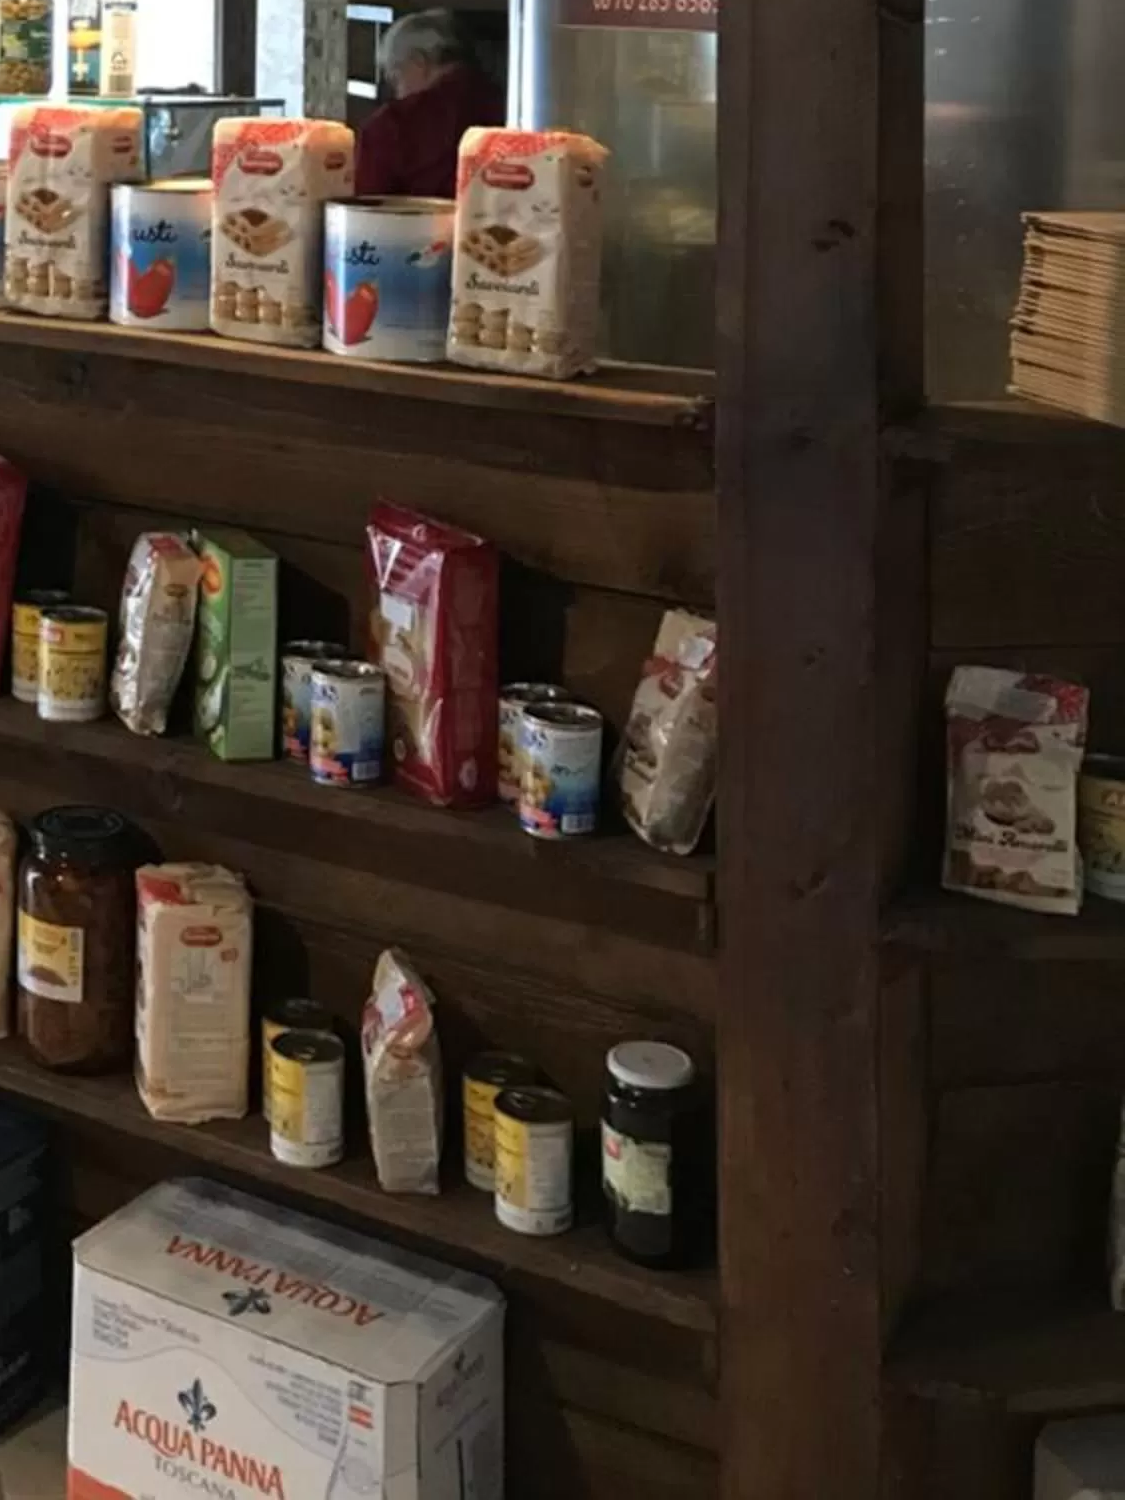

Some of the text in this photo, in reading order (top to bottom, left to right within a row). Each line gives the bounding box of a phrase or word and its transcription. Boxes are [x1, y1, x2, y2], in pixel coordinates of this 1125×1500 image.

[165, 1235, 386, 1327] ACQUA PANNA
[114, 1399, 196, 1462] ACQUA
[200, 1436, 285, 1500] PANNA
[153, 1453, 237, 1500] TOSCANA
